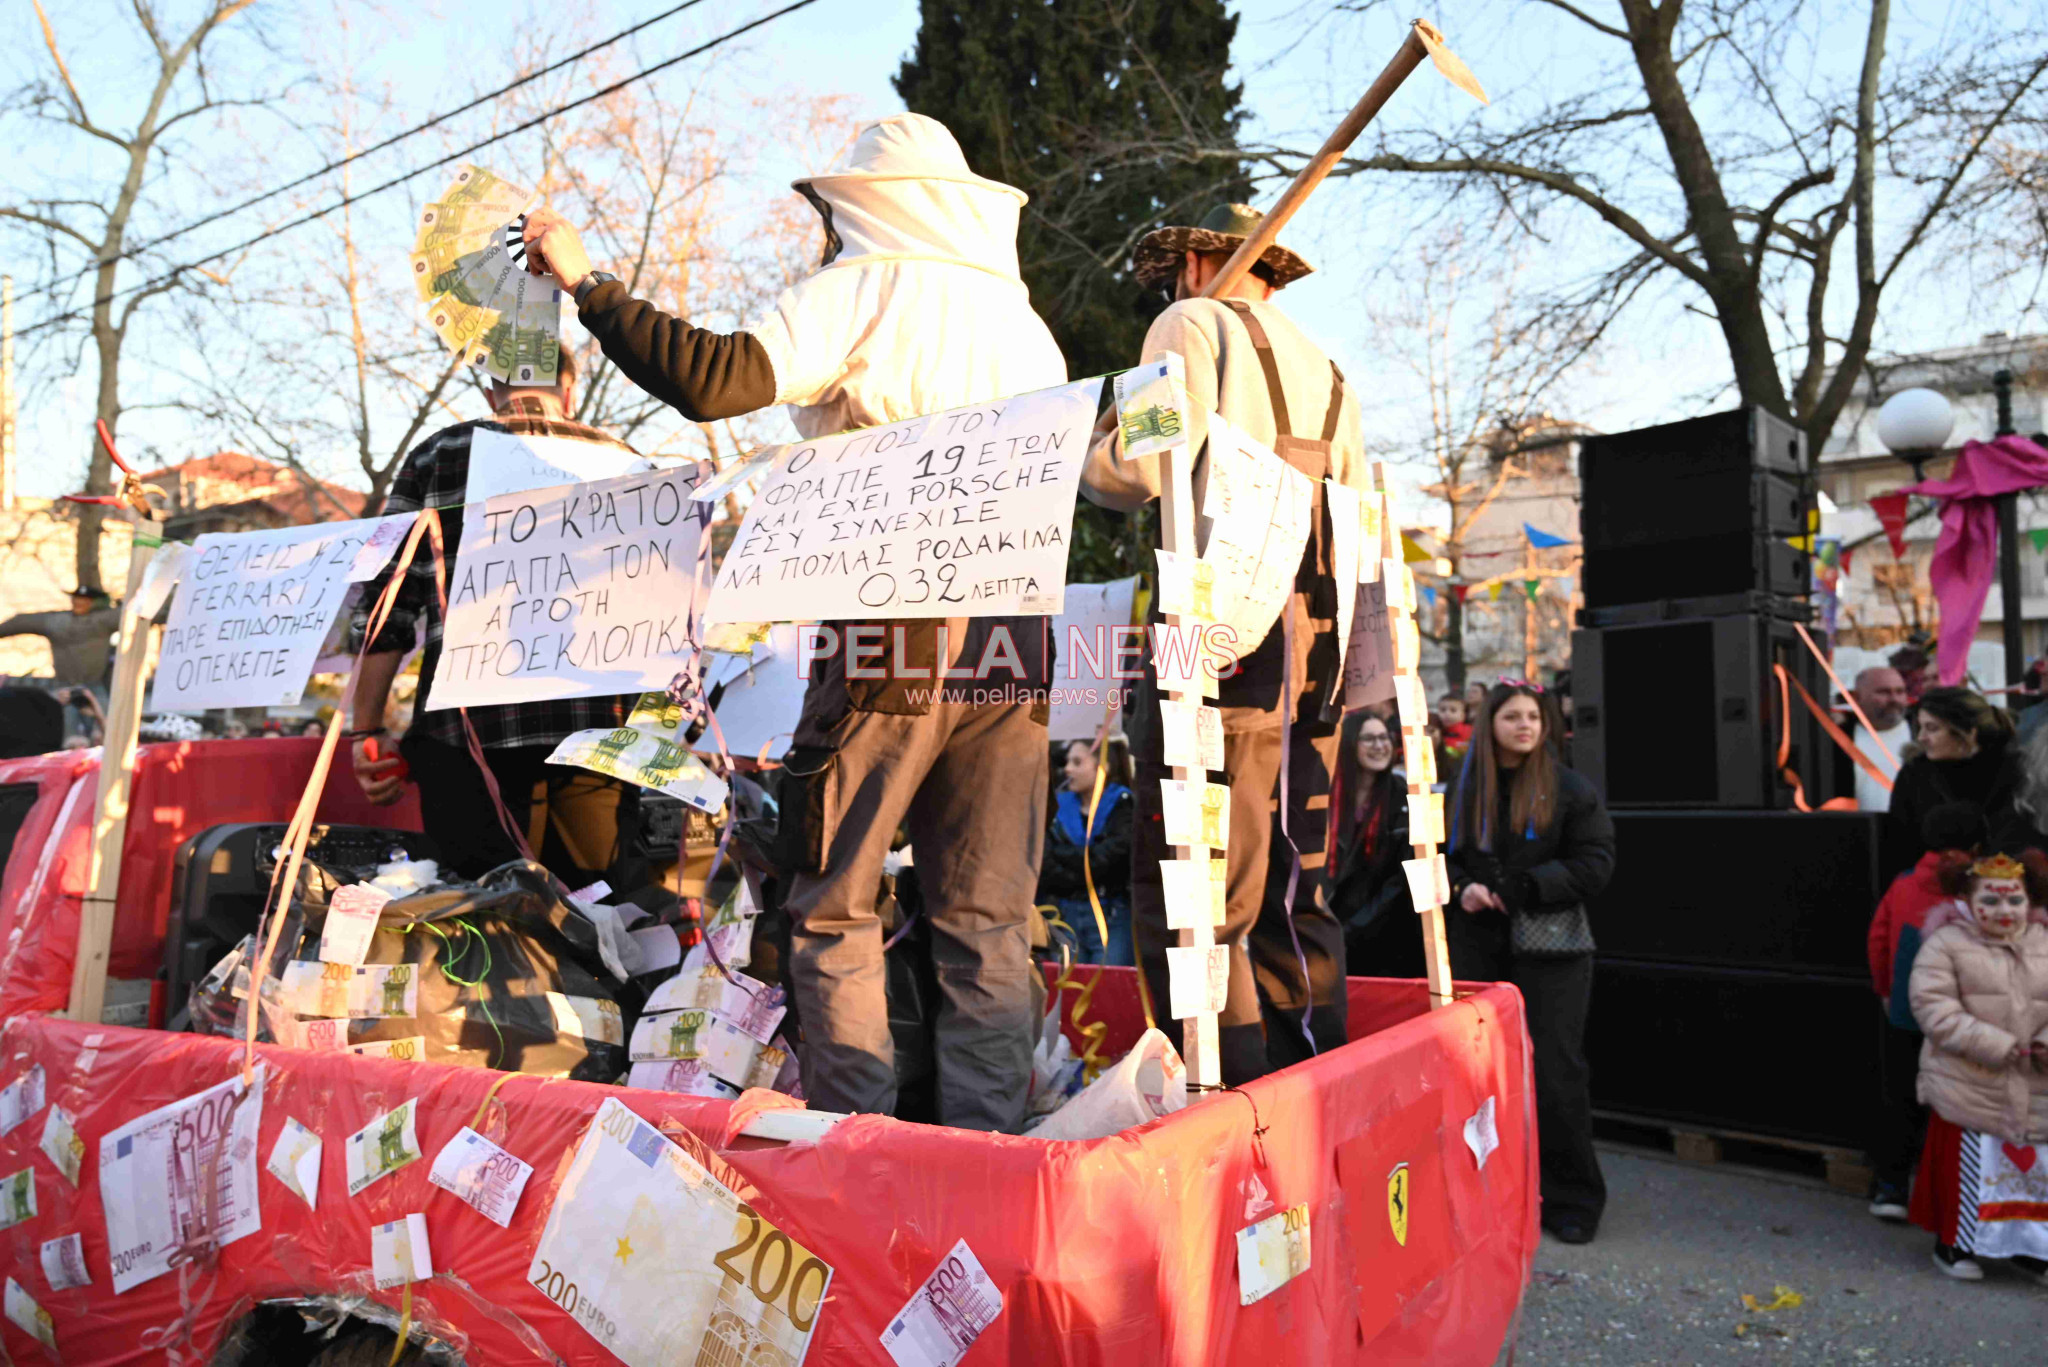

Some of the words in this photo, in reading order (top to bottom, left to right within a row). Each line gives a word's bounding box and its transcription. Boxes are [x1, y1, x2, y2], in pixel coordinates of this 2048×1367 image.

[540, 340, 556, 374] 100
[787, 447, 817, 474] Ο
[948, 406, 1007, 435] ΤΟΥ
[1159, 410, 1180, 437] 100
[752, 510, 800, 534] ΚΑΙ
[817, 492, 889, 520] ΕΧΕΙ
[908, 461, 1062, 505] PORSCHE
[765, 464, 883, 505] ΦΡΑΠΕ
[912, 445, 965, 480] 19
[483, 504, 537, 545] ΤΟ
[560, 475, 701, 539] ΚΡΑΤΟΣ
[739, 529, 803, 558] ΕΣΥ
[829, 500, 1001, 542] ΣΥΝΕΧΙΣΕ
[194, 543, 299, 581] ΘΕΛΕΙΣ
[455, 552, 580, 605] ΑΓΑΠΑ
[602, 538, 673, 582] ΤΟΝ
[723, 563, 762, 590] ΝΑ
[779, 543, 893, 581] ΠΟΥΛΑΣ
[917, 524, 1064, 562] ΡΟΔΑΚΙΝΑ
[971, 576, 1040, 600] ΛΕΠΤΑ
[165, 623, 208, 656] ΠΑΡΕ
[217, 610, 325, 642] ΕΠΙΔΟΤΗΣΗ
[483, 588, 609, 635] ΑΓΡΟΤΗ
[176, 648, 290, 691] ΟΠΕΚΕΠΕ
[612, 729, 639, 746] 100
[321, 962, 352, 981] 200
[391, 966, 411, 983] 100
[308, 1021, 336, 1040] 500
[683, 1011, 705, 1027] 100
[391, 1041, 415, 1060] 100
[178, 1090, 236, 1153] 500
[600, 1100, 635, 1145] 200
[487, 1152, 520, 1182] 500
[1281, 1204, 1310, 1235] 200
[714, 1202, 829, 1333] 200
[927, 1256, 965, 1305] 500
[533, 1259, 578, 1314] 200
[577, 1295, 617, 1337] EURO
